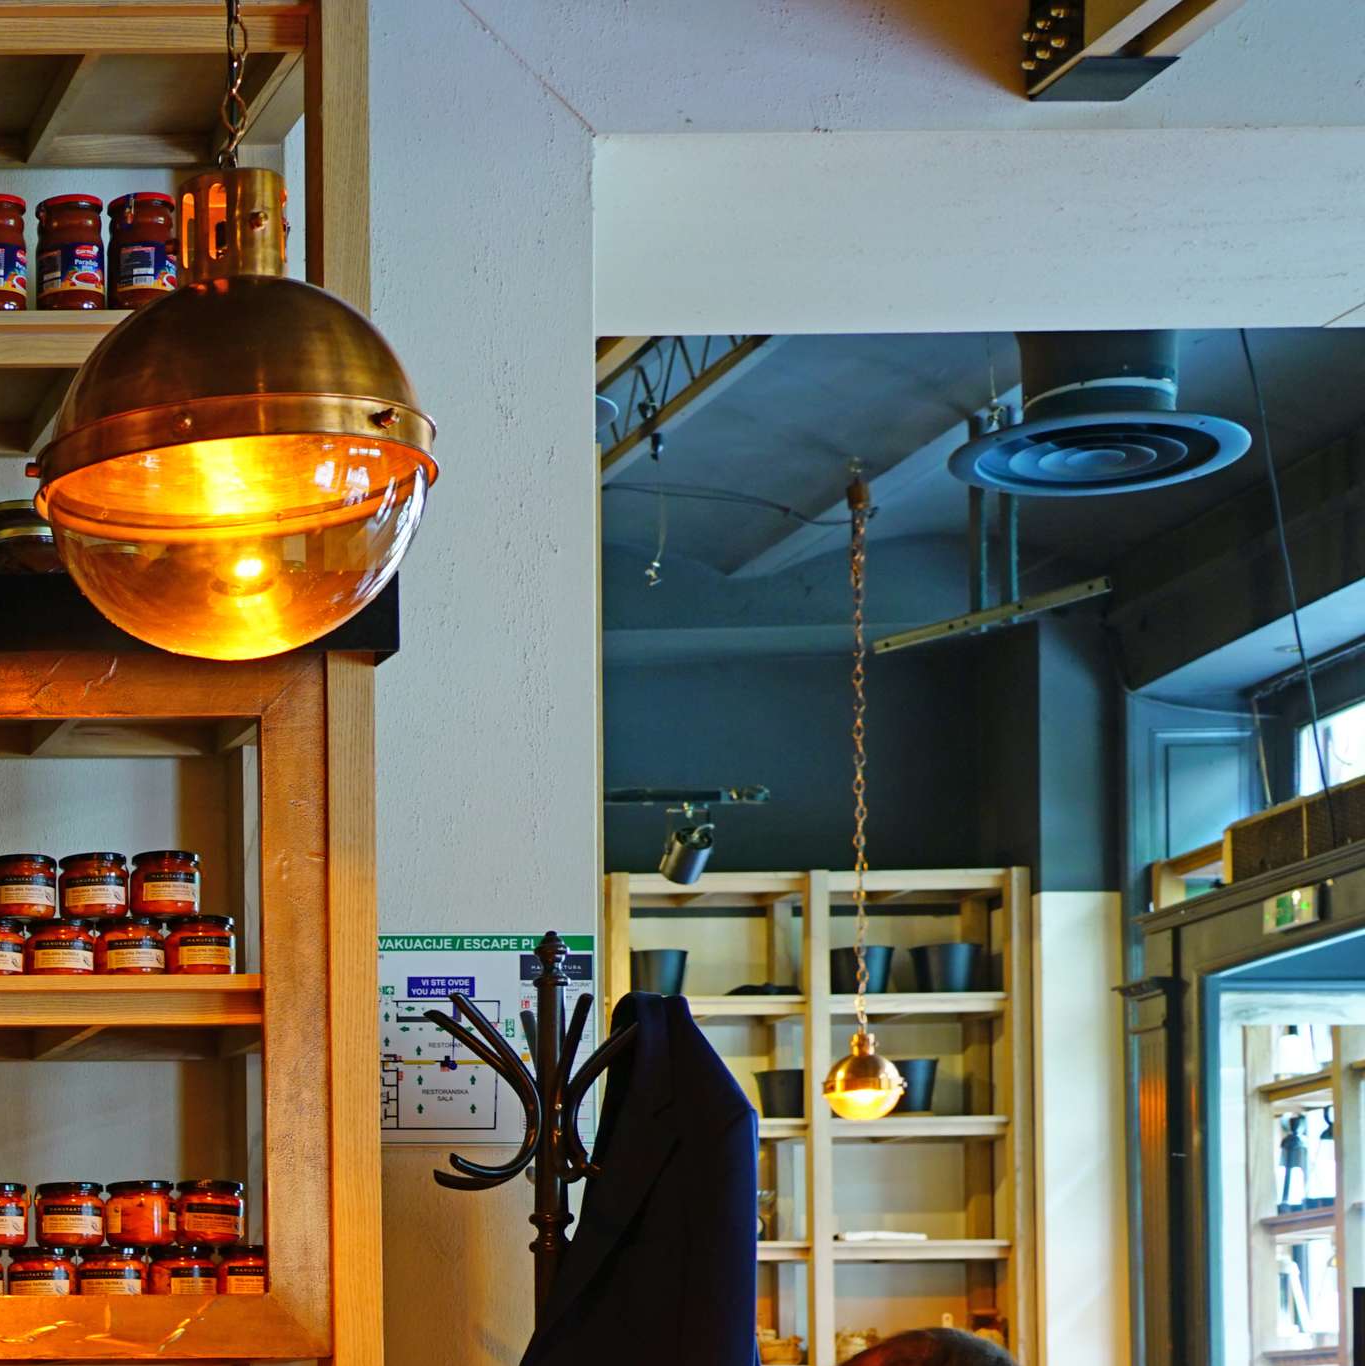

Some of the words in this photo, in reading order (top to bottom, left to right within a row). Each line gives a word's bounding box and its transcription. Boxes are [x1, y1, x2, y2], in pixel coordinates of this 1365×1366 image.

[377, 938, 453, 950] VAKUACIJE
[463, 938, 517, 950] ESCAPE
[522, 938, 536, 950] PL
[411, 988, 428, 996] YOU
[430, 988, 446, 996] ARE
